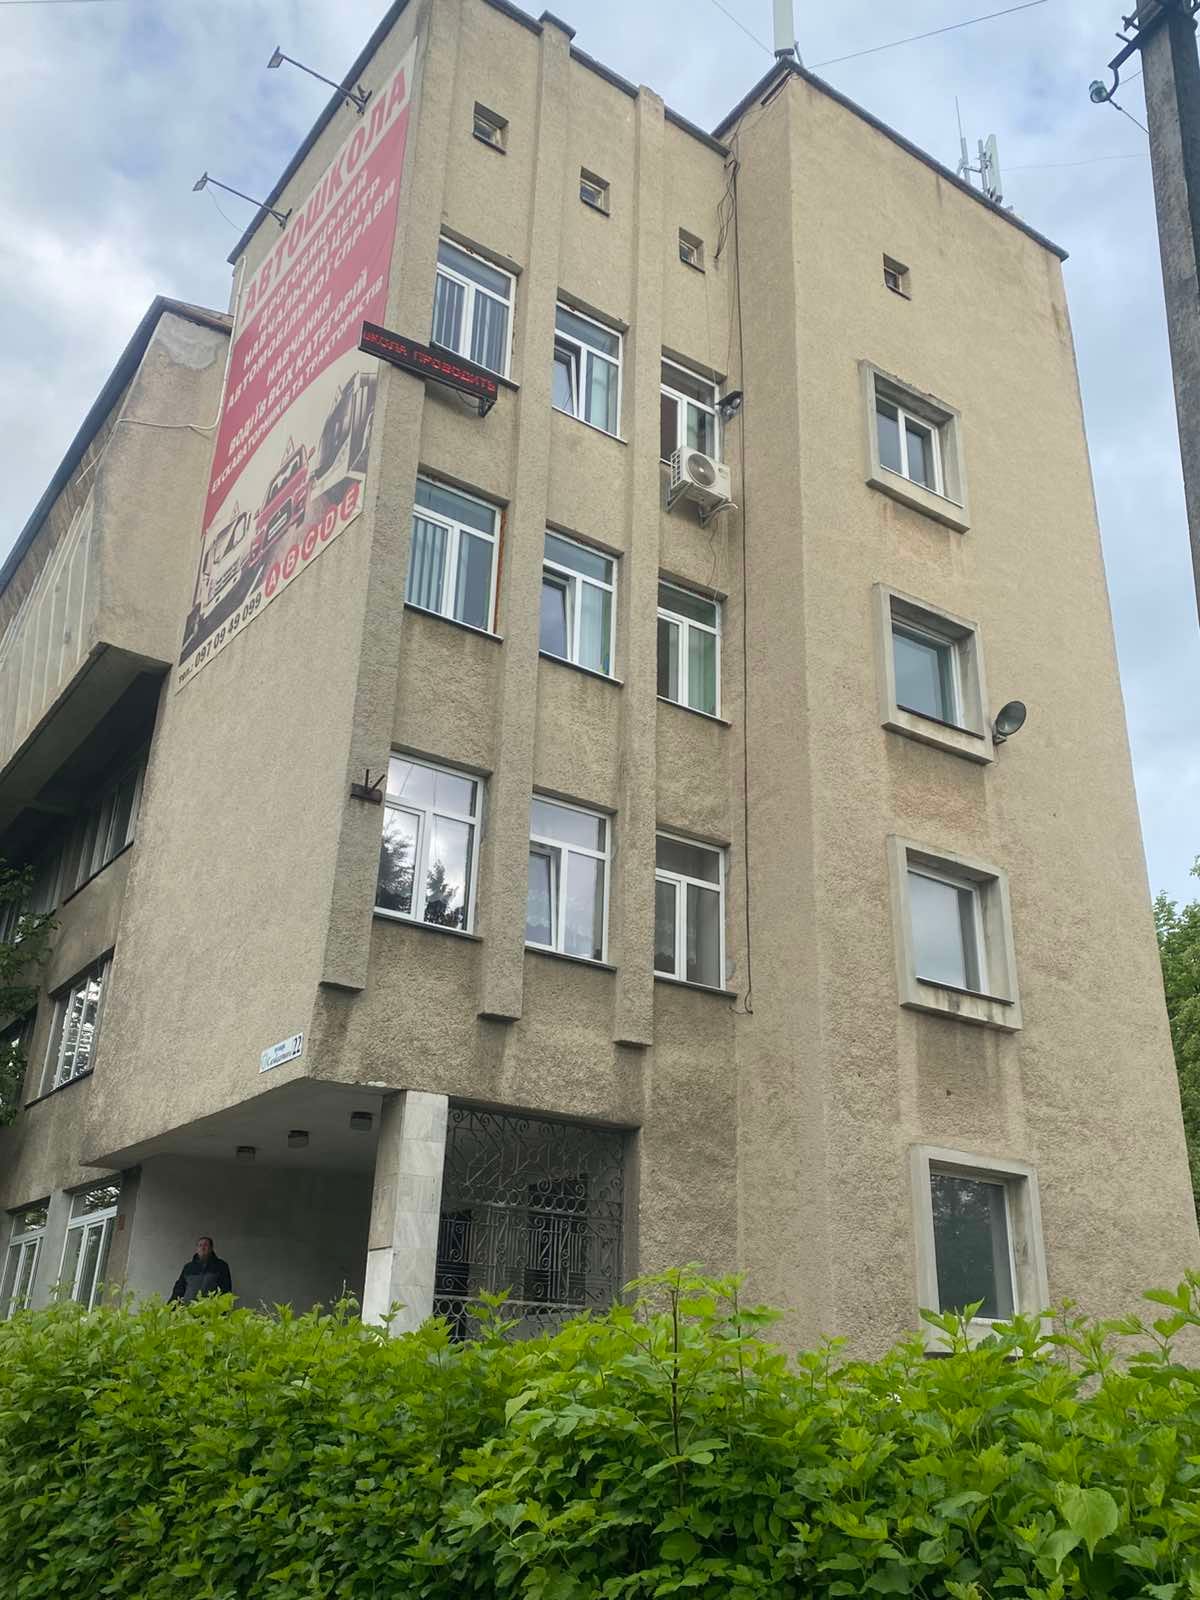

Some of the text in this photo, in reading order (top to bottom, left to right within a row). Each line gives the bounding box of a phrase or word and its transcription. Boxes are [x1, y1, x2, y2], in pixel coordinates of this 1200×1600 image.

[242, 68, 405, 321] АВТОШКОЛА
[245, 178, 379, 366] НАВЧАЛЬНИЙ ЦЕНТР
[228, 179, 394, 411] АВТОМОБІЛЬНОЇ СПРАВИ
[229, 266, 367, 456] ВОДІЇВ ВСІХ КАТЕГОРІЙ
[267, 294, 330, 384] НАВЧАННЯ
[292, 372, 305, 396] ТА
[307, 274, 383, 378] ТРАКТОРИСТІВ
[194, 643, 211, 668] 097
[213, 629, 225, 649] 09
[228, 614, 240, 634] 49
[242, 592, 262, 620] 099
[292, 1035, 302, 1055] 22
